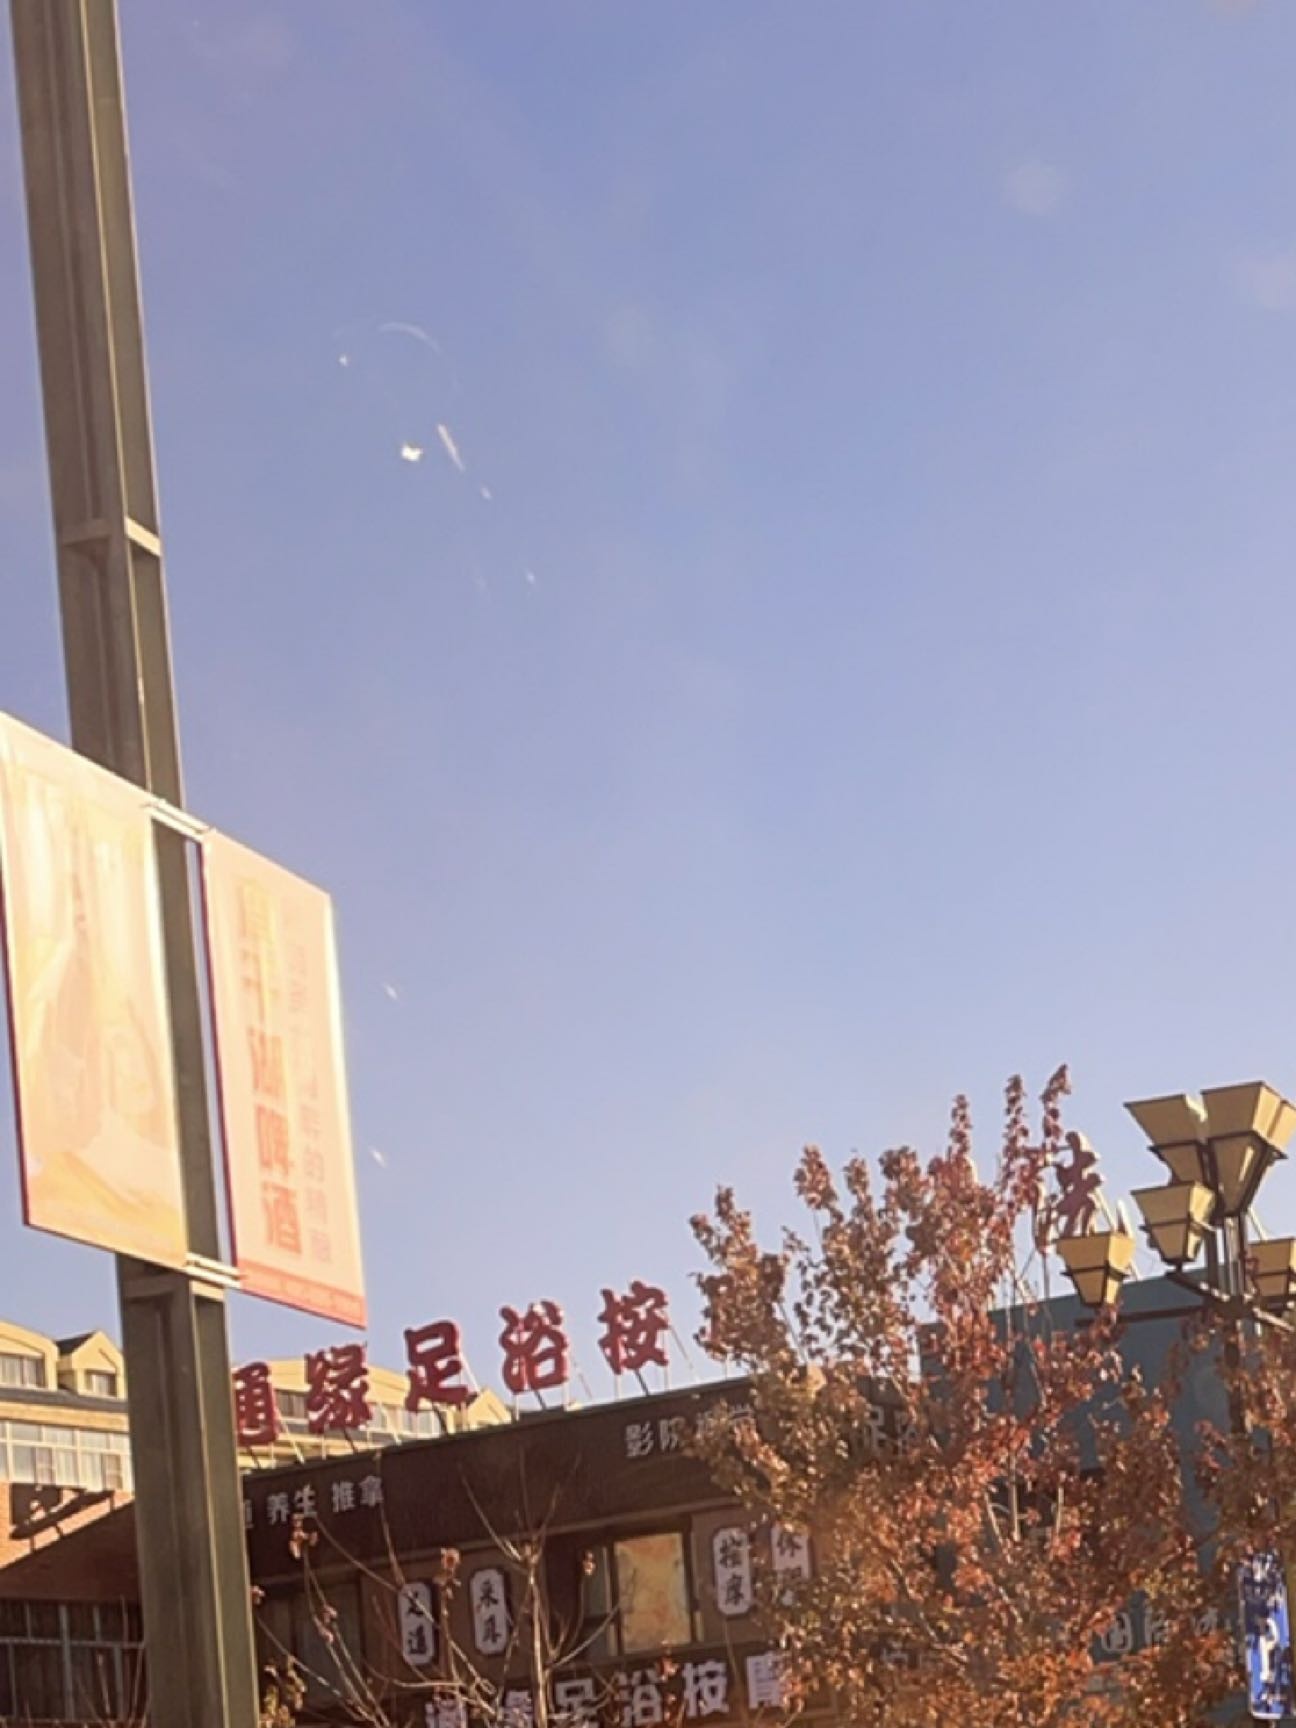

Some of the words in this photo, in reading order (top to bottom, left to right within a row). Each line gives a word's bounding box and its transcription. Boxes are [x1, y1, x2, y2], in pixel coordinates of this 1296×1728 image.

[233, 1279, 765, 1446] 通缘足浴按
